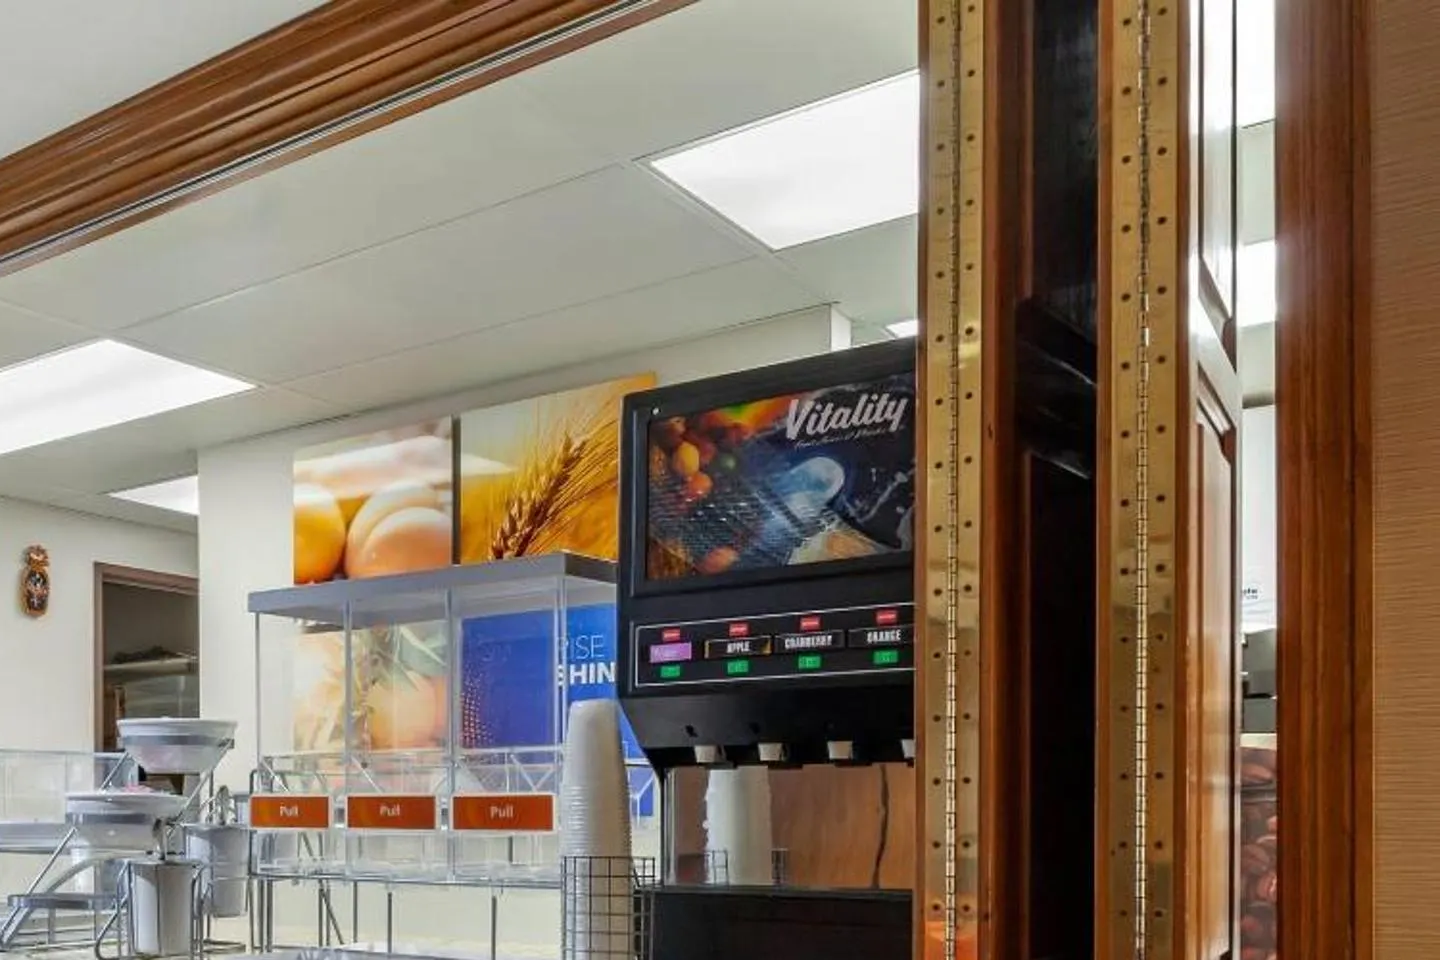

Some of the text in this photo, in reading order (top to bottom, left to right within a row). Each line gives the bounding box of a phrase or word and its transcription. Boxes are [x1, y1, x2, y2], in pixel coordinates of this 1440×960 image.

[786, 392, 908, 441] Vitality
[867, 629, 901, 644] ORANGE
[726, 640, 750, 654] APPLE
[557, 661, 616, 686] SHIN
[279, 804, 299, 817] Pull
[379, 803, 401, 817] Pull
[490, 804, 514, 819] Pull
